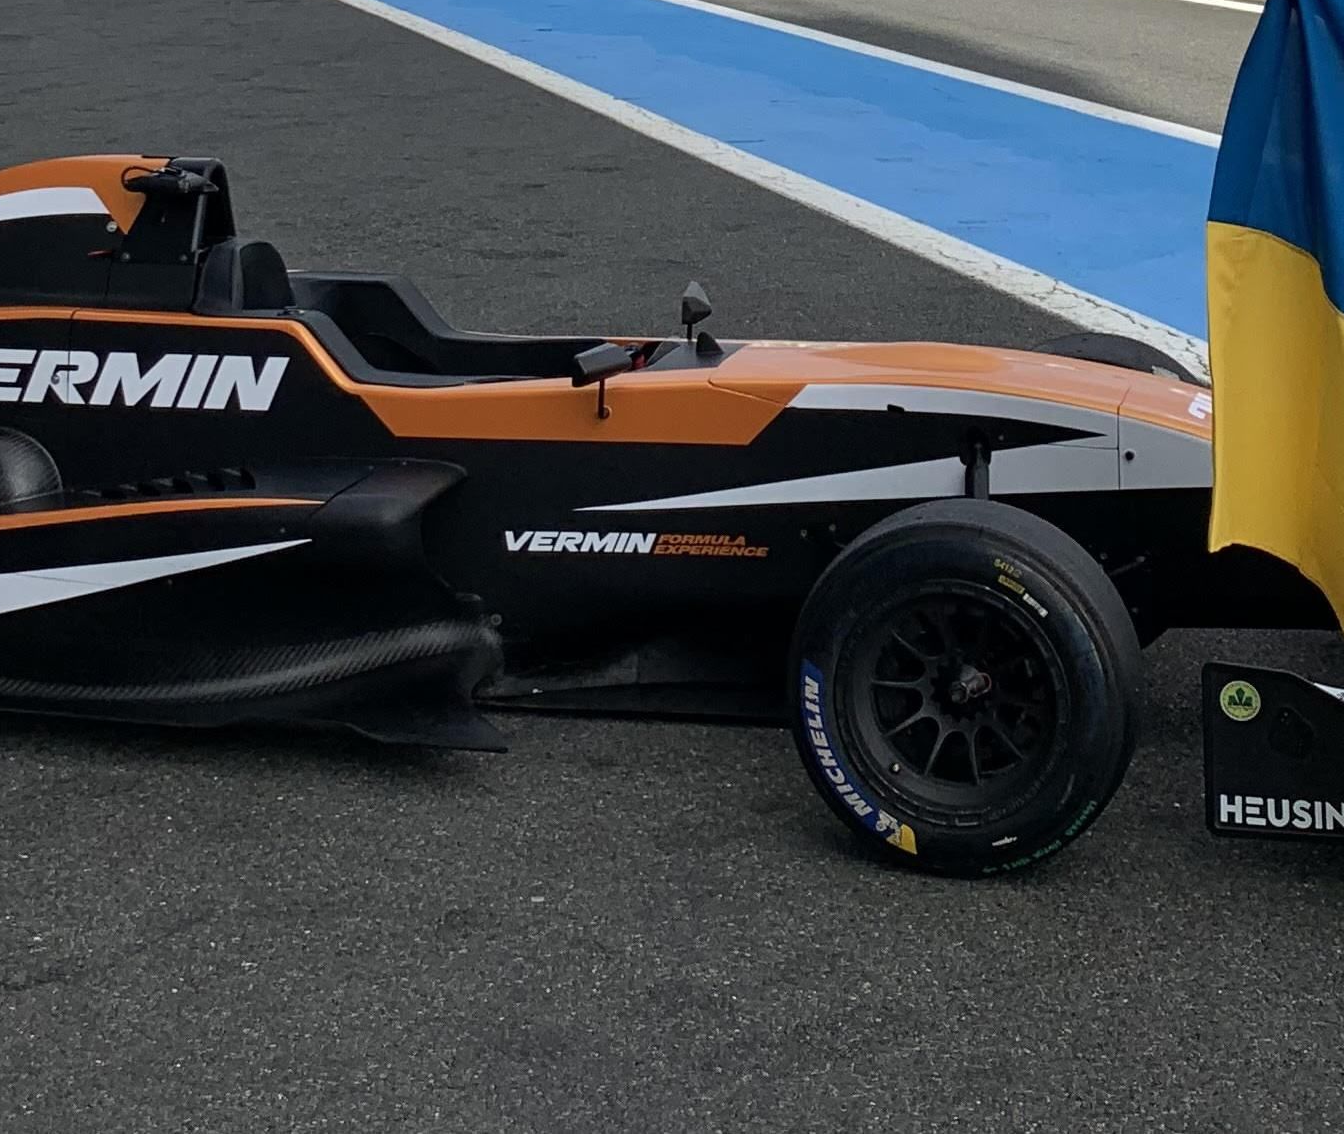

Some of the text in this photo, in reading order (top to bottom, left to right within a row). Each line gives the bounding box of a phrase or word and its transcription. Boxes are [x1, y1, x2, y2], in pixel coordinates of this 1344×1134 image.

[505, 530, 746, 554] VERMIN FORMULA
[654, 545, 769, 557] EXPERIENCE
[805, 676, 873, 817] MICHELIN
